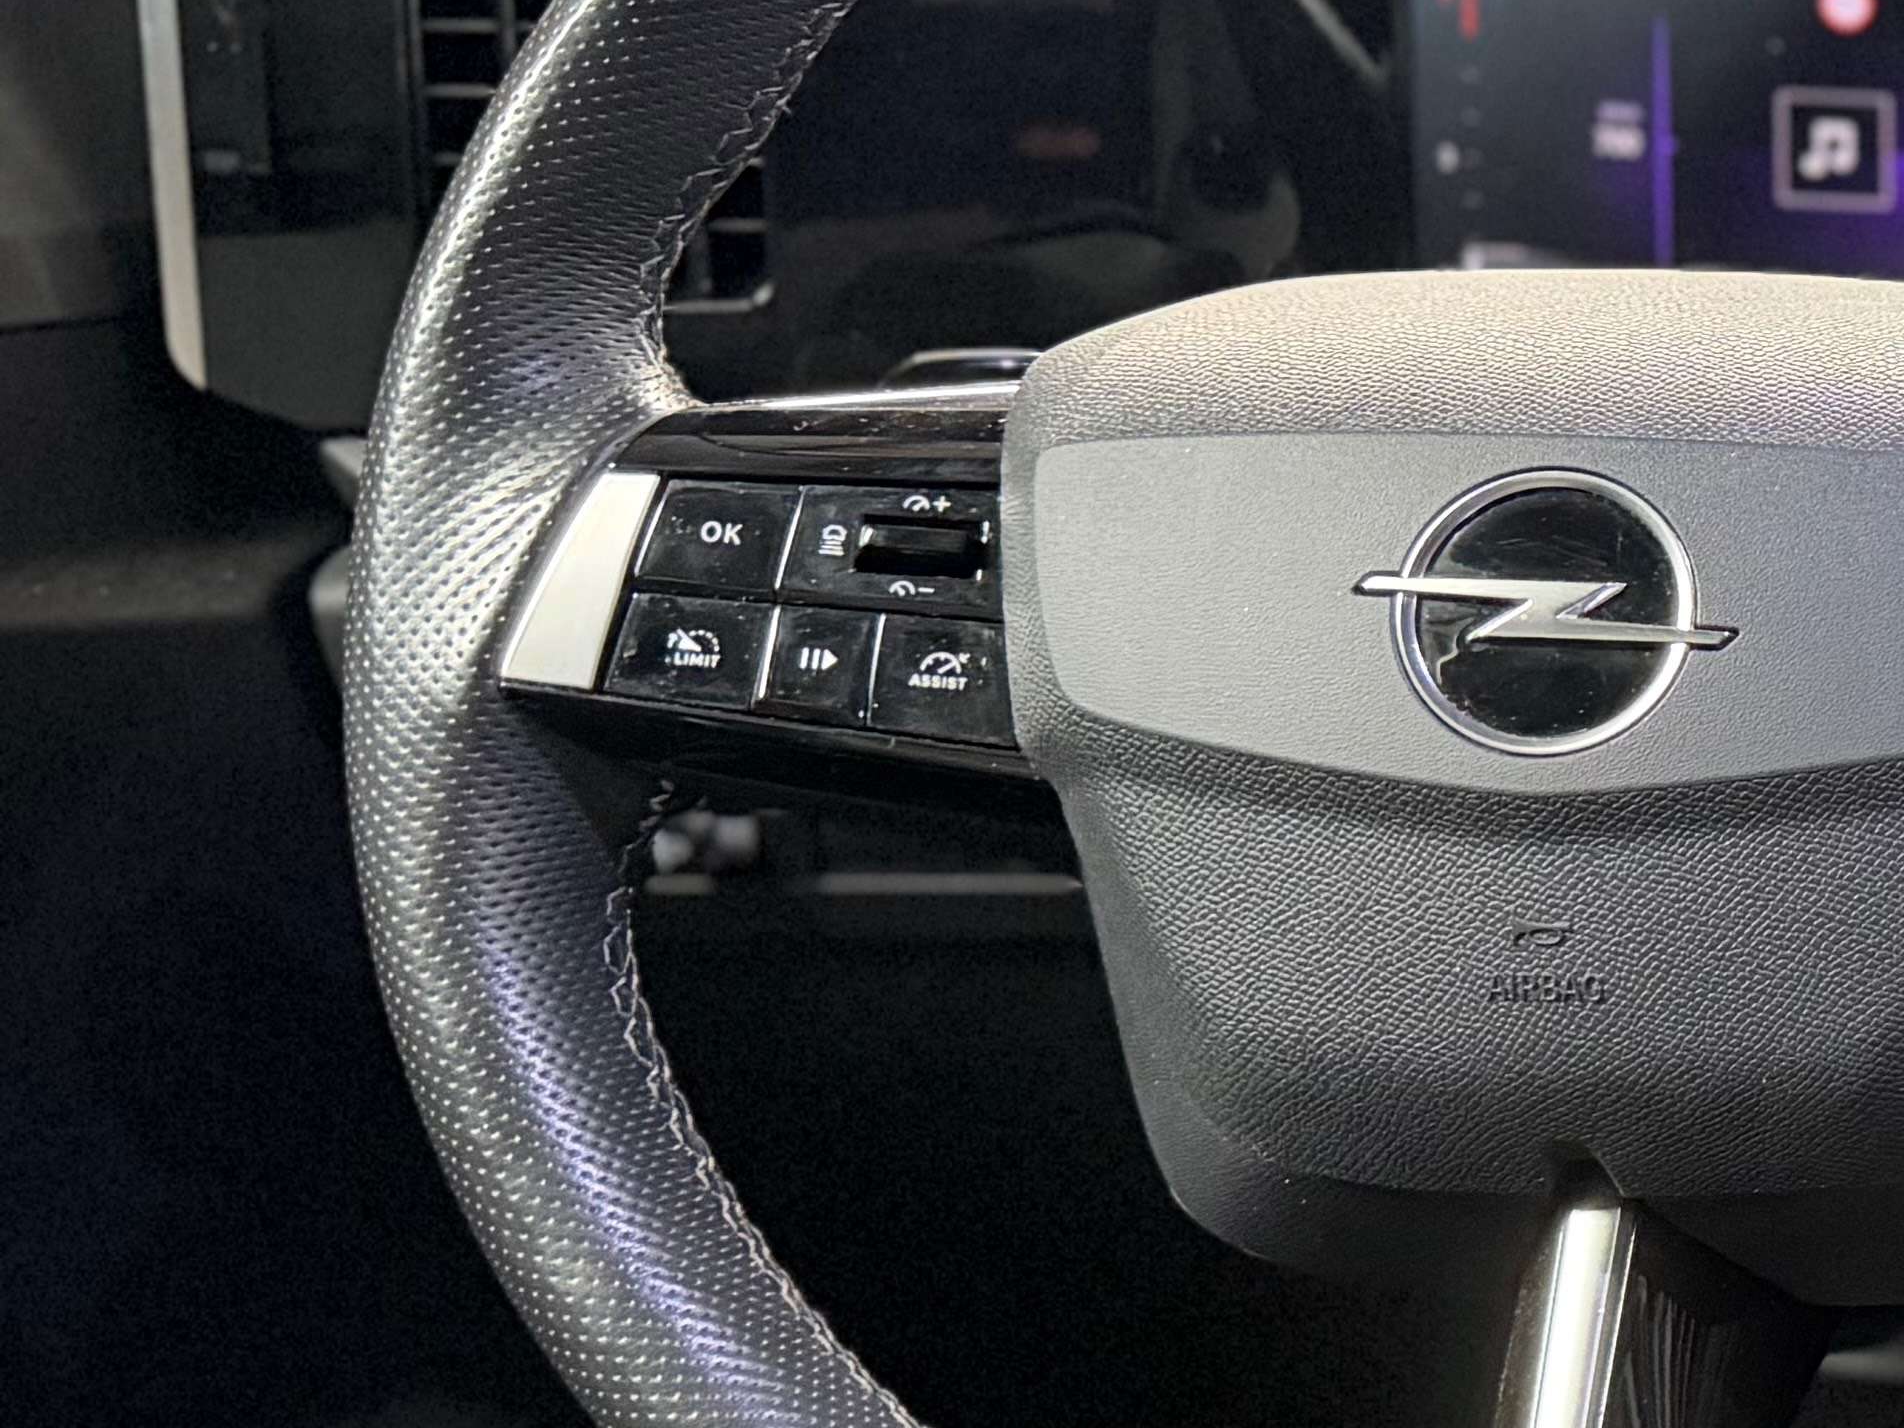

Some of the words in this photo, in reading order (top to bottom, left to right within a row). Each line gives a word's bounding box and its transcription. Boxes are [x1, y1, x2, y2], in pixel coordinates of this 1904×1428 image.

[700, 520, 743, 547] OK
[673, 651, 722, 669] LIMIT
[907, 673, 969, 692] ASSIST
[1487, 974, 1606, 1004] AIRBAG
